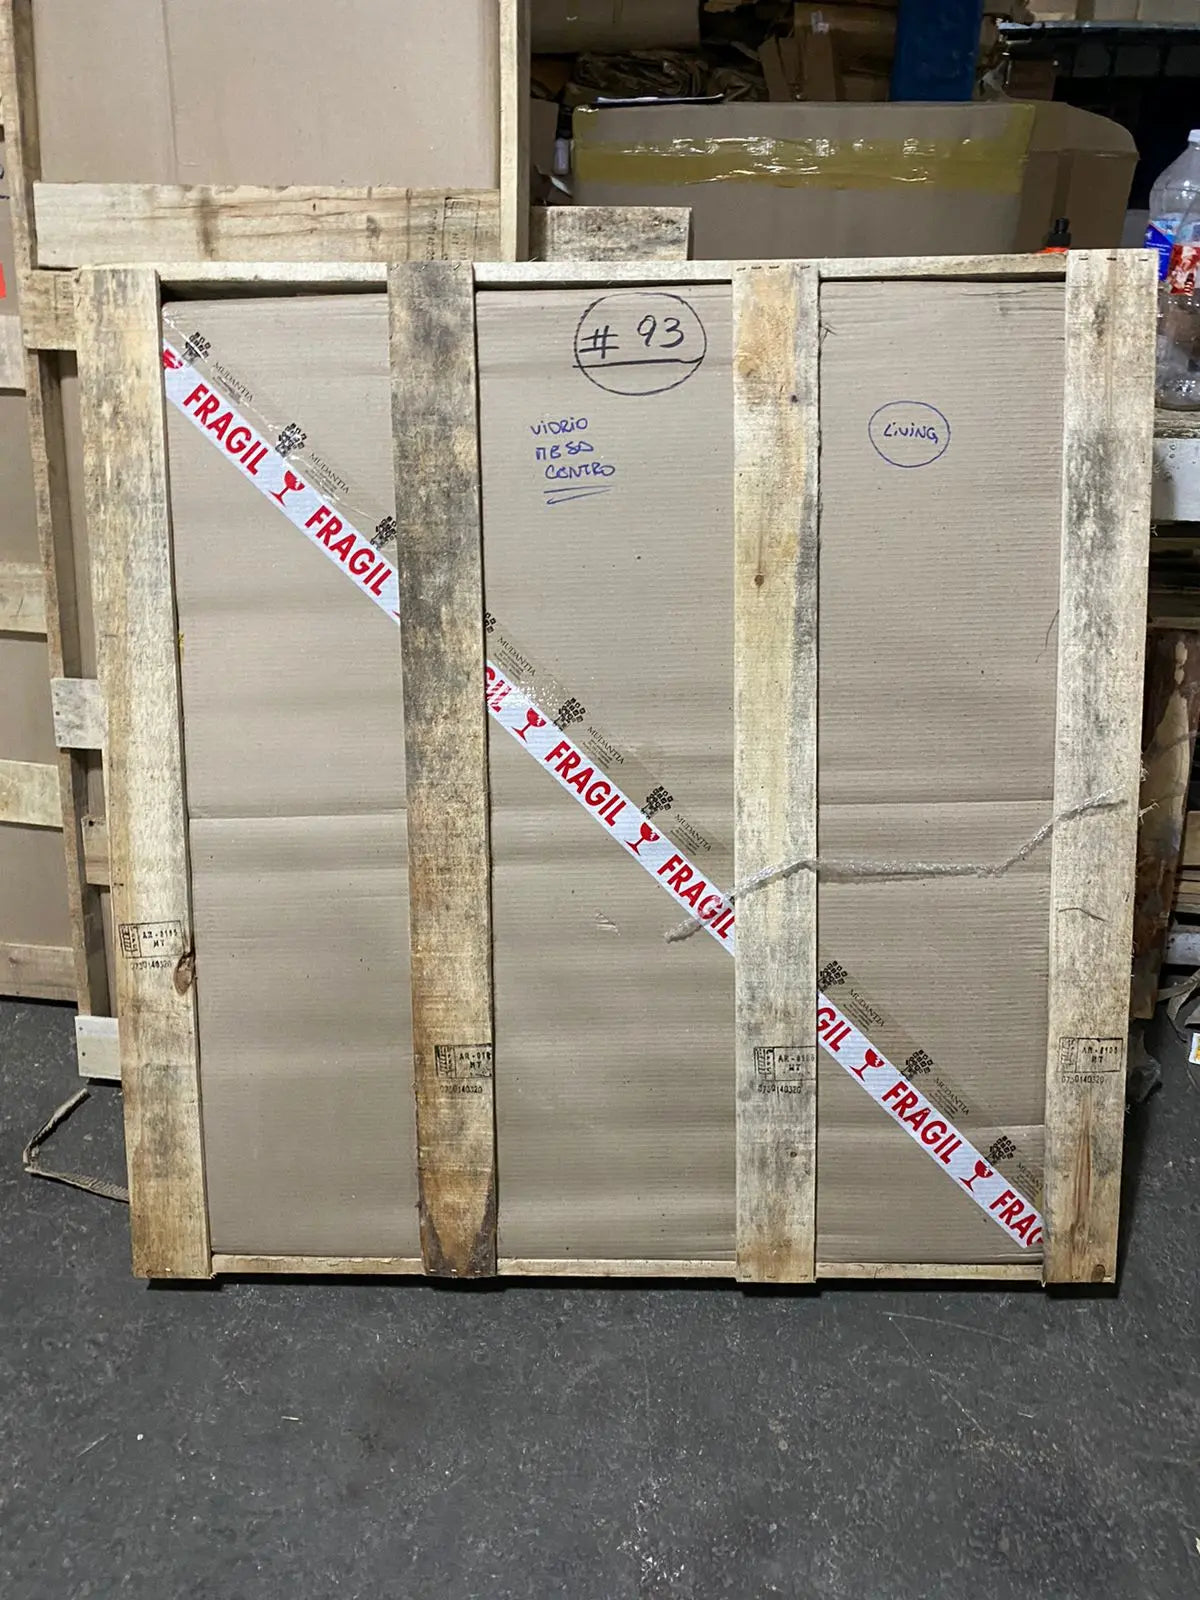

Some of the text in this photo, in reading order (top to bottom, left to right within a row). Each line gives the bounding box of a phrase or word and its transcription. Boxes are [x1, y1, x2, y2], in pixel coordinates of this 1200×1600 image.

[579, 315, 684, 359] # 93
[182, 383, 269, 476] FRAGIL
[309, 452, 349, 494] MUDANTIA
[305, 505, 392, 597] FRAGIL
[497, 636, 535, 677] MUDANTIA
[587, 726, 624, 764] MUDANTIA
[544, 740, 627, 828] FRAGIL
[675, 813, 711, 851] MUDANTIA
[656, 854, 735, 939] FRAGIL
[817, 1007, 852, 1052] GIL
[881, 1080, 963, 1165] FRAGIL
